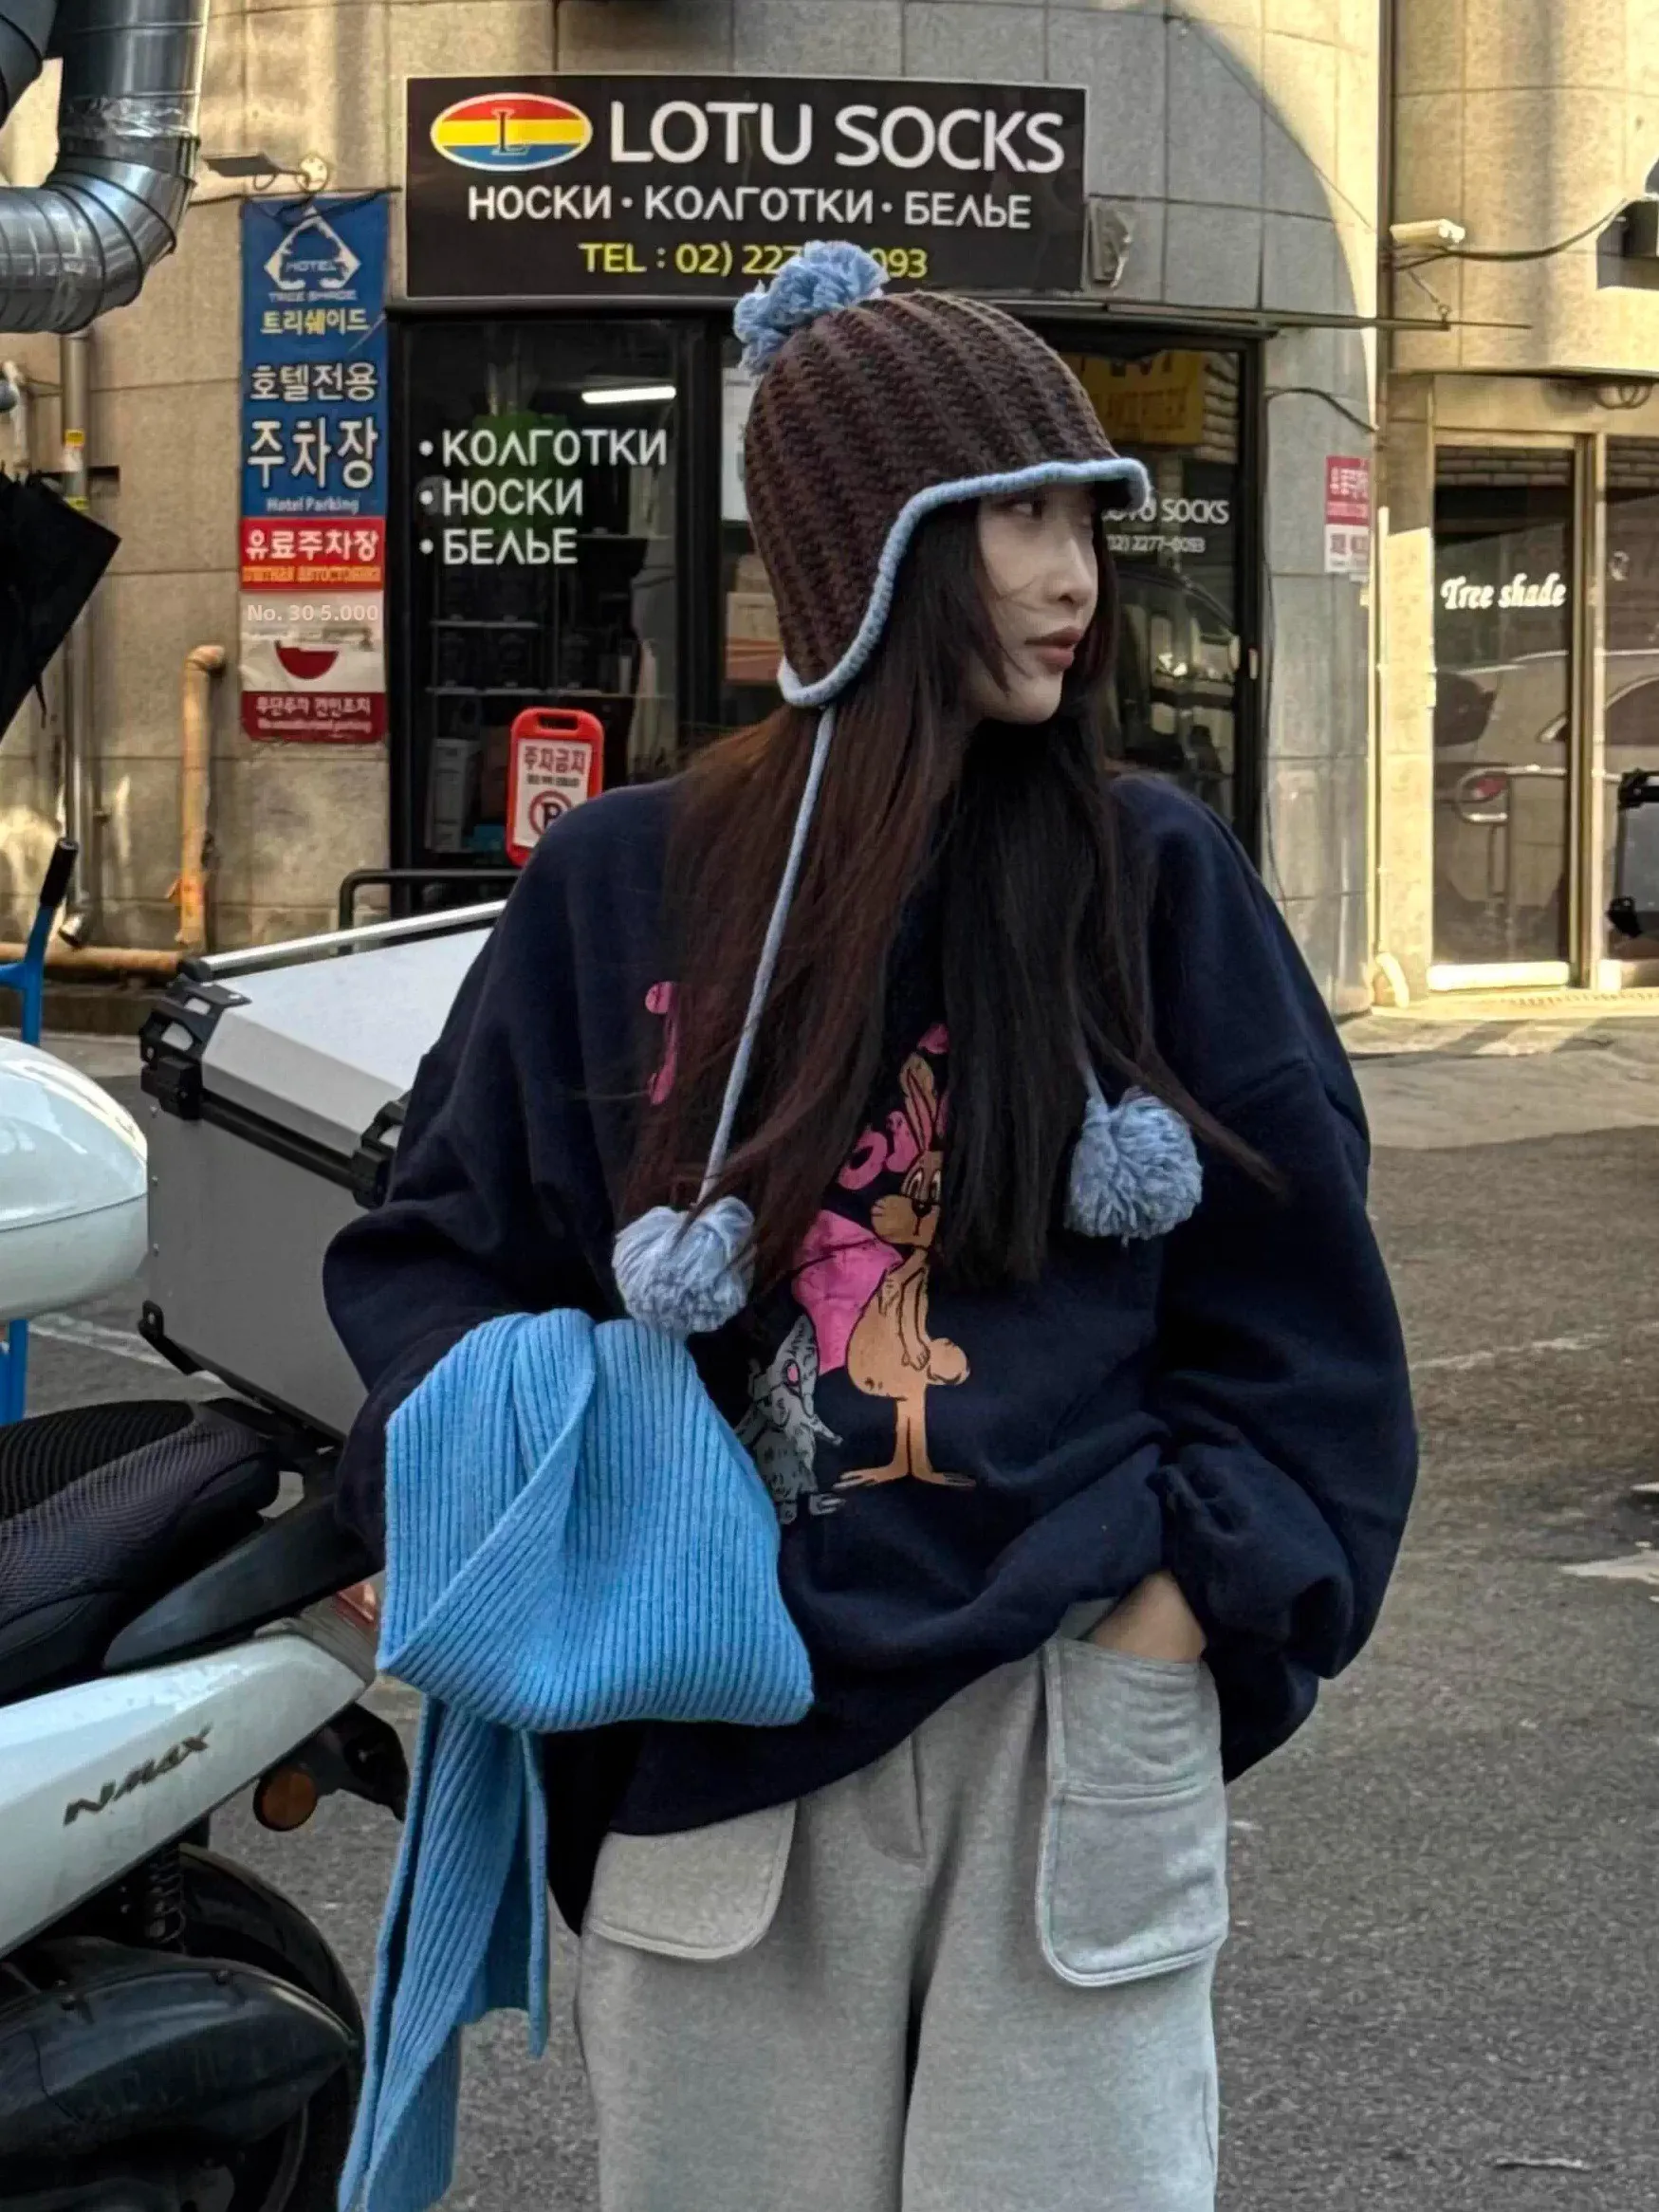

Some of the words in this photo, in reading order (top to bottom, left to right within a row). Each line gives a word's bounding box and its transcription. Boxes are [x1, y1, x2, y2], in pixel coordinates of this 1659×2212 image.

[491, 105, 531, 156] L
[610, 100, 813, 166] LOTU
[834, 104, 1065, 174] SOCKS
[468, 185, 612, 221] НОСКИ
[644, 185, 874, 224] КОЛГОТКИ
[904, 190, 1032, 230] БЕЛЬЕ
[579, 242, 647, 274] TEL
[674, 240, 733, 278] 02)
[250, 361, 378, 402] 호텔전용
[247, 416, 379, 489] 주차장
[442, 429, 668, 468] КОЛГОТКИ
[442, 478, 583, 516] НОСКИ
[1160, 498, 1229, 525] SOCKS
[244, 528, 379, 562] 유료주차장
[443, 527, 579, 566] БЕЛЬЕ
[1440, 576, 1495, 610] Tree
[1498, 572, 1567, 609] shade
[248, 604, 283, 621] No.
[288, 604, 315, 621] 30
[321, 604, 379, 621] 5.000
